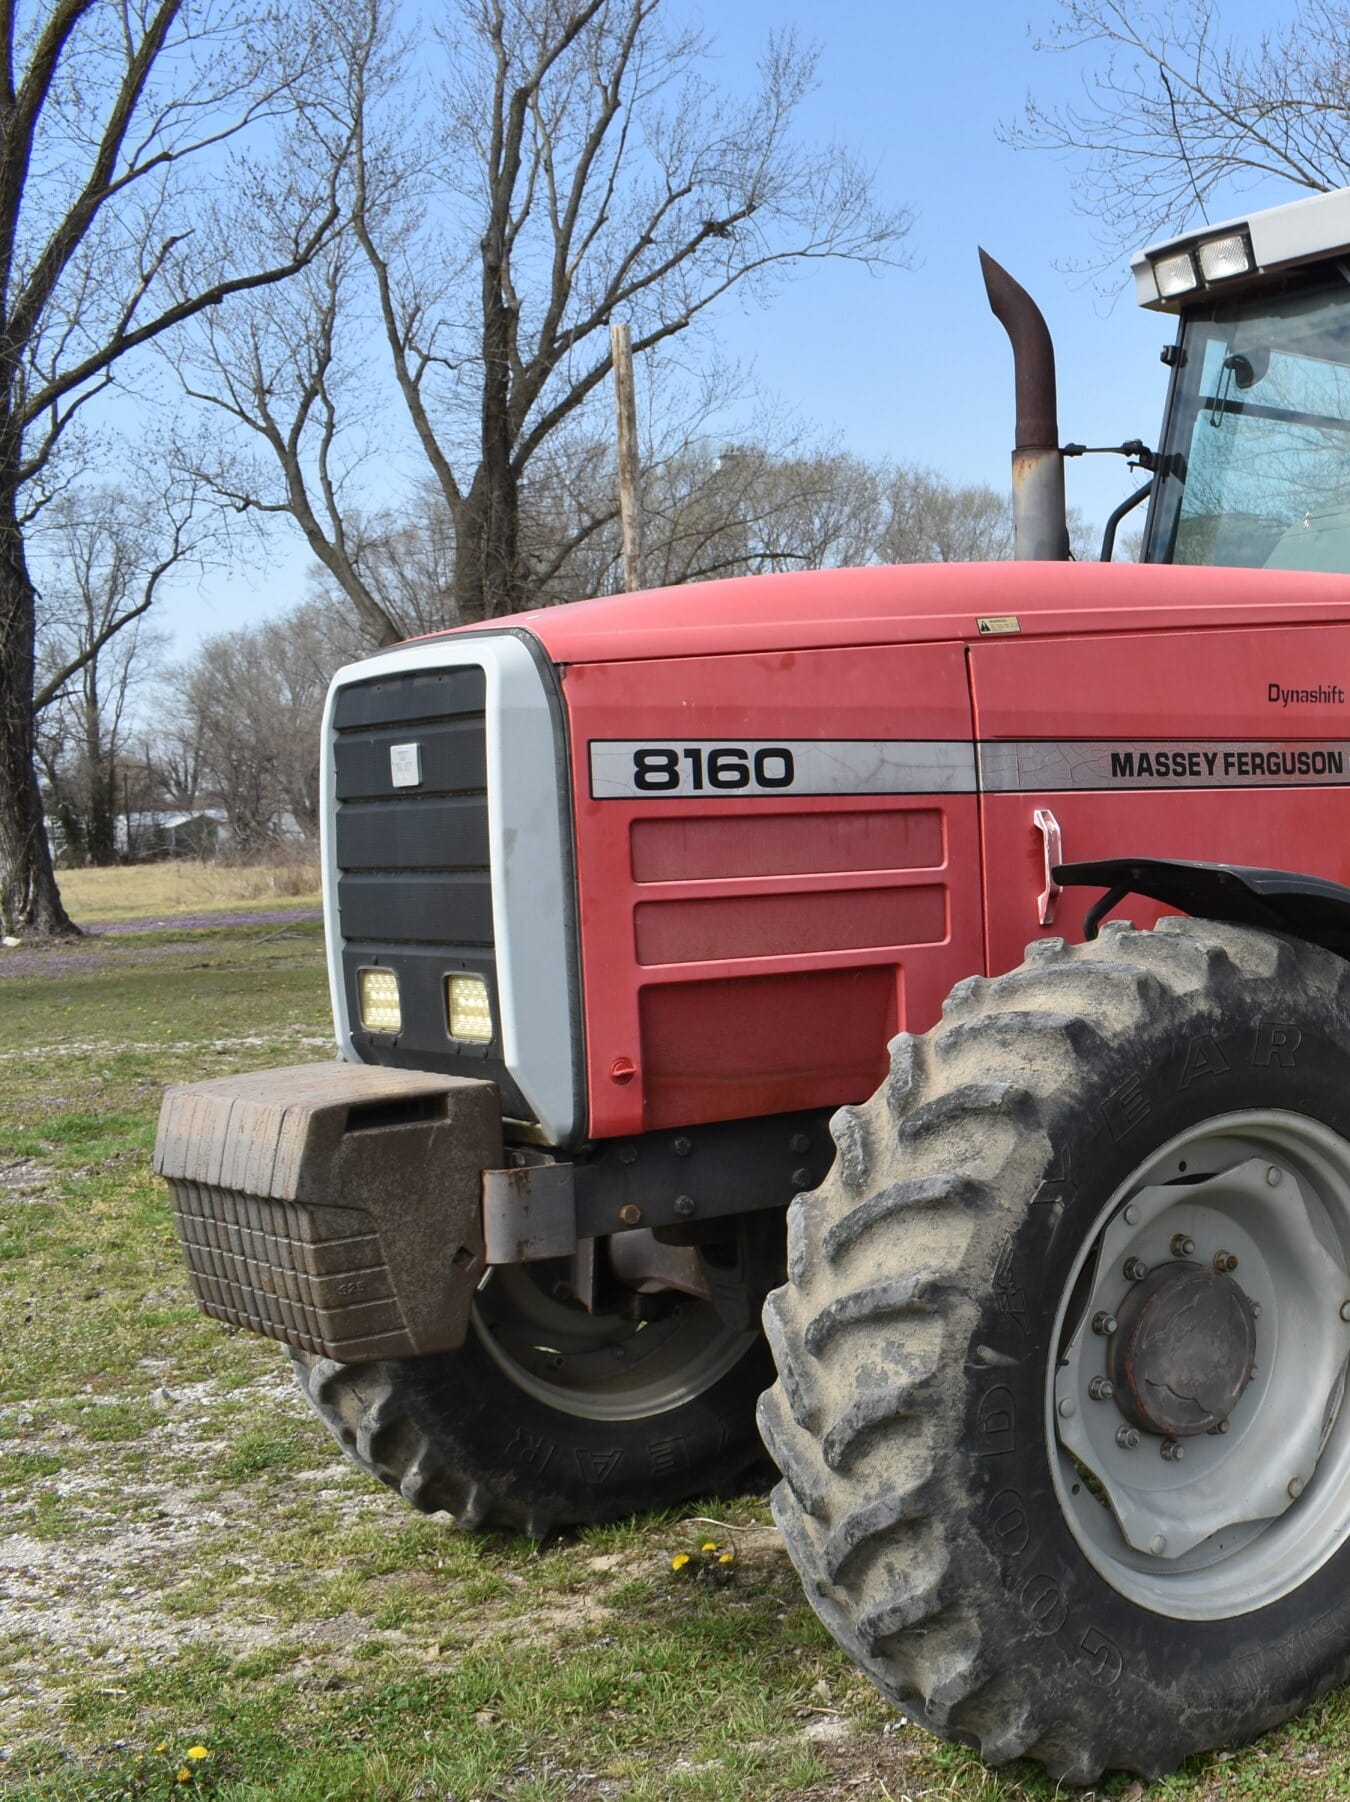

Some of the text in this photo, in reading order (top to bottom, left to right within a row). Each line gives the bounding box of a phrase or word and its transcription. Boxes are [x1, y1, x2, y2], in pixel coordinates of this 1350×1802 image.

[1268, 683, 1344, 708] Dynashift
[633, 748, 794, 791] 8160
[1111, 751, 1343, 777] MASSEY FERGUSON
